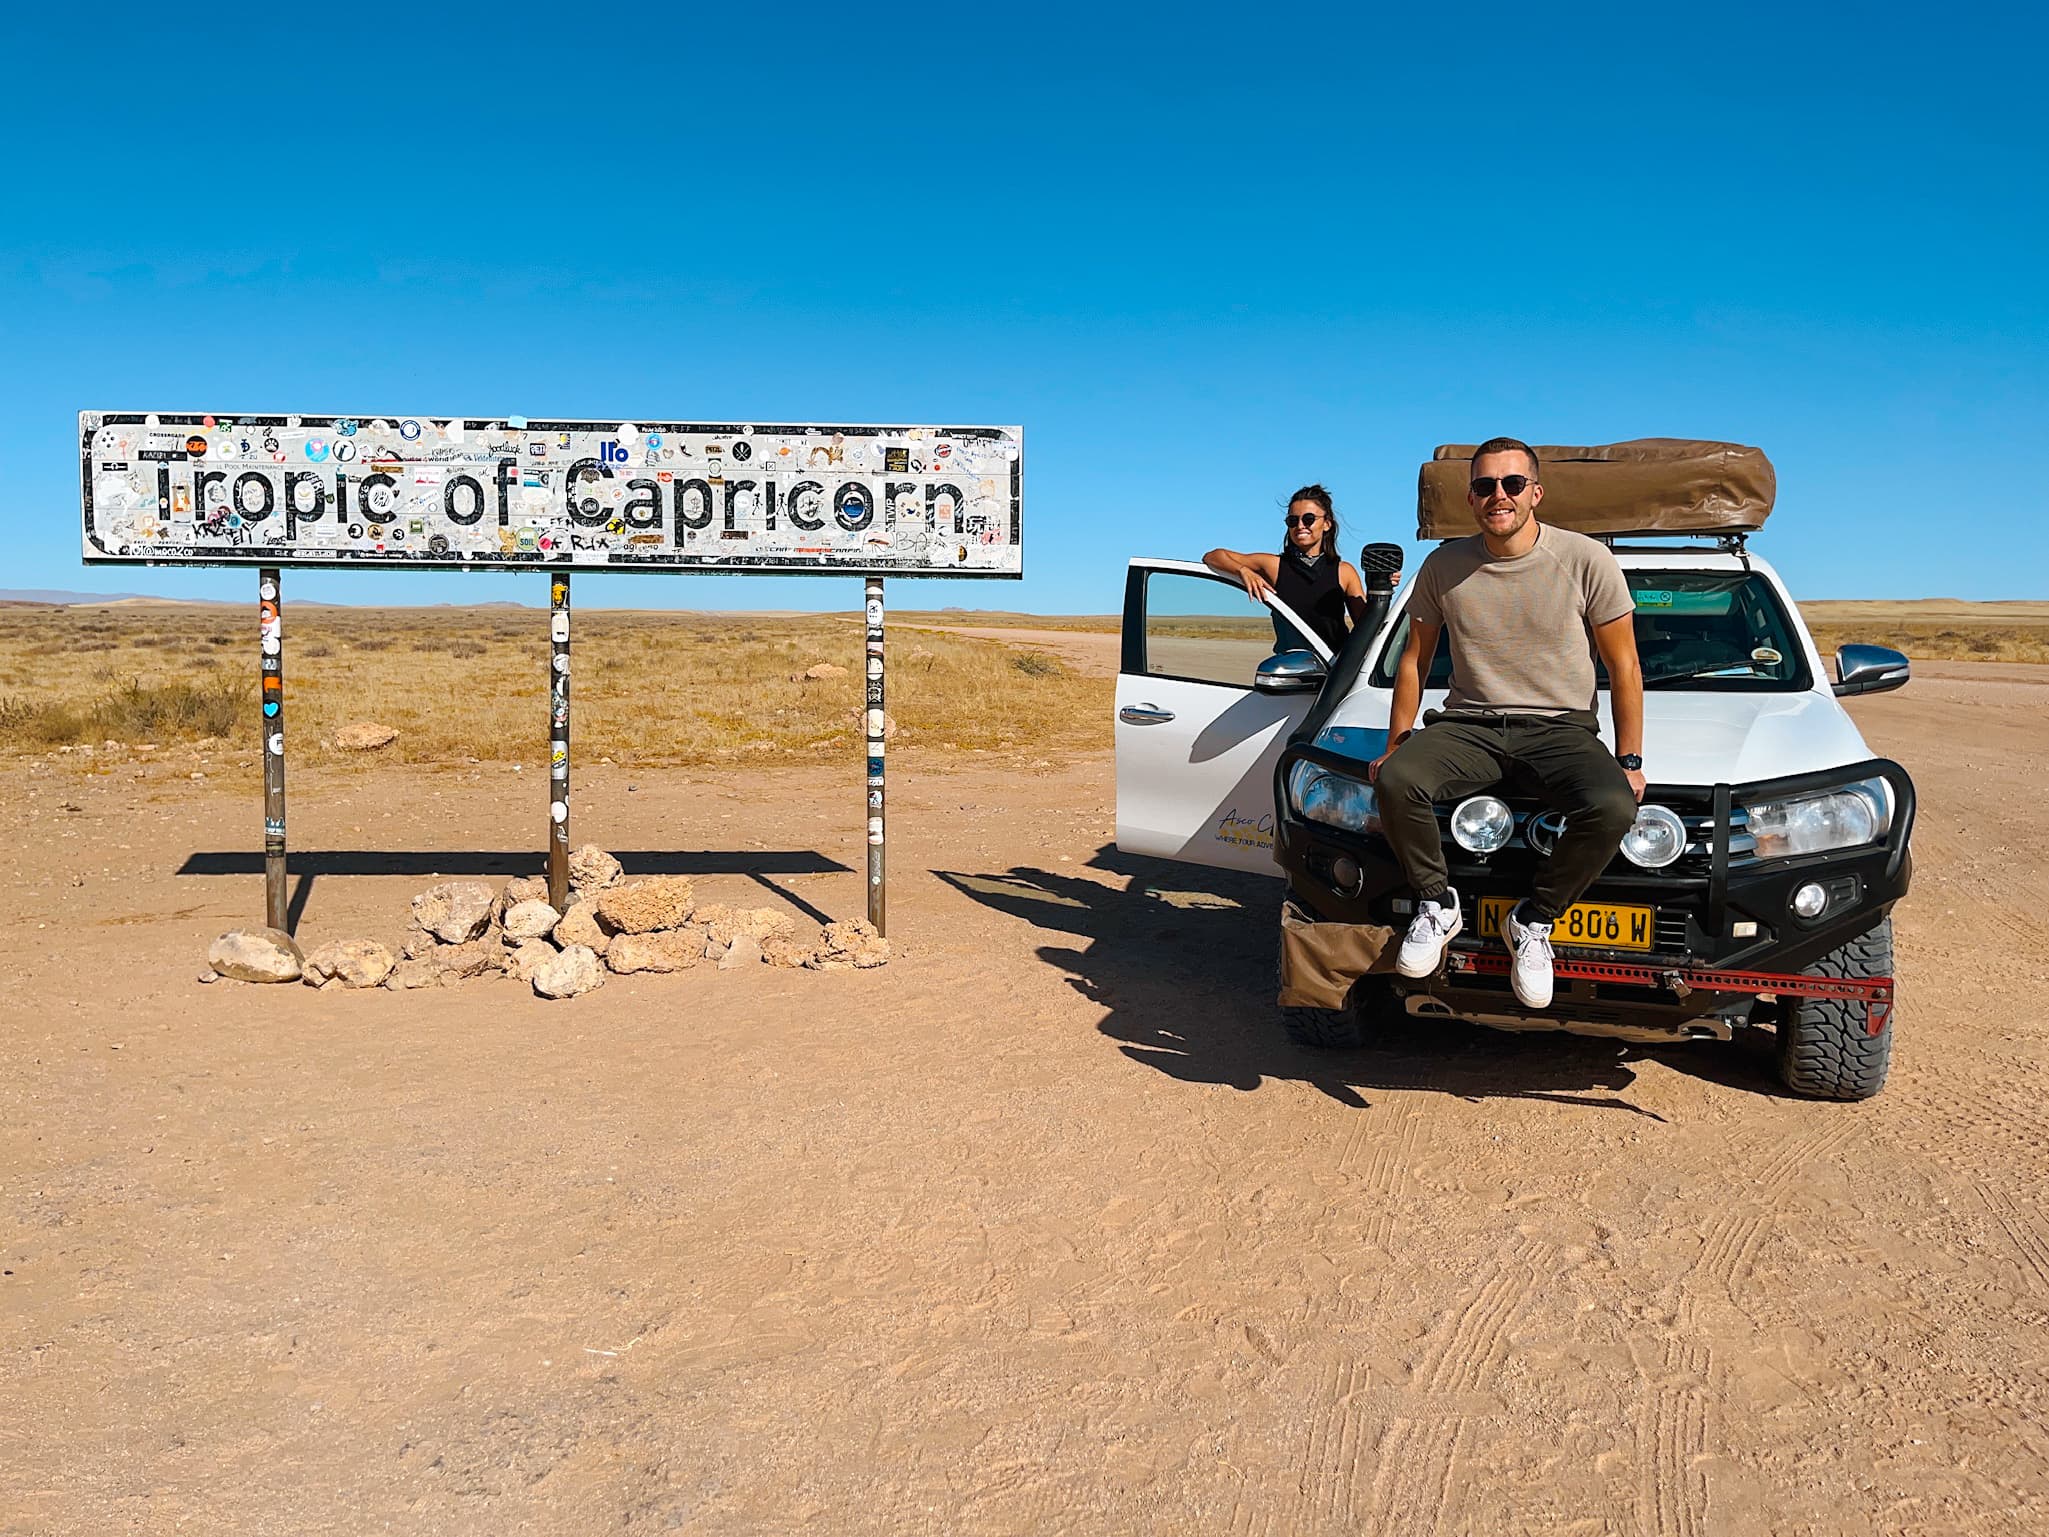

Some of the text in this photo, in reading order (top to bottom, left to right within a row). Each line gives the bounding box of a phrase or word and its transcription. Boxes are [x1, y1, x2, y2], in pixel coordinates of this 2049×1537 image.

[138, 450, 964, 548] Tropic of Capricorn
[1218, 808, 1256, 830] Asco
[1485, 903, 1499, 933] N
[1631, 912, 1647, 943] W
